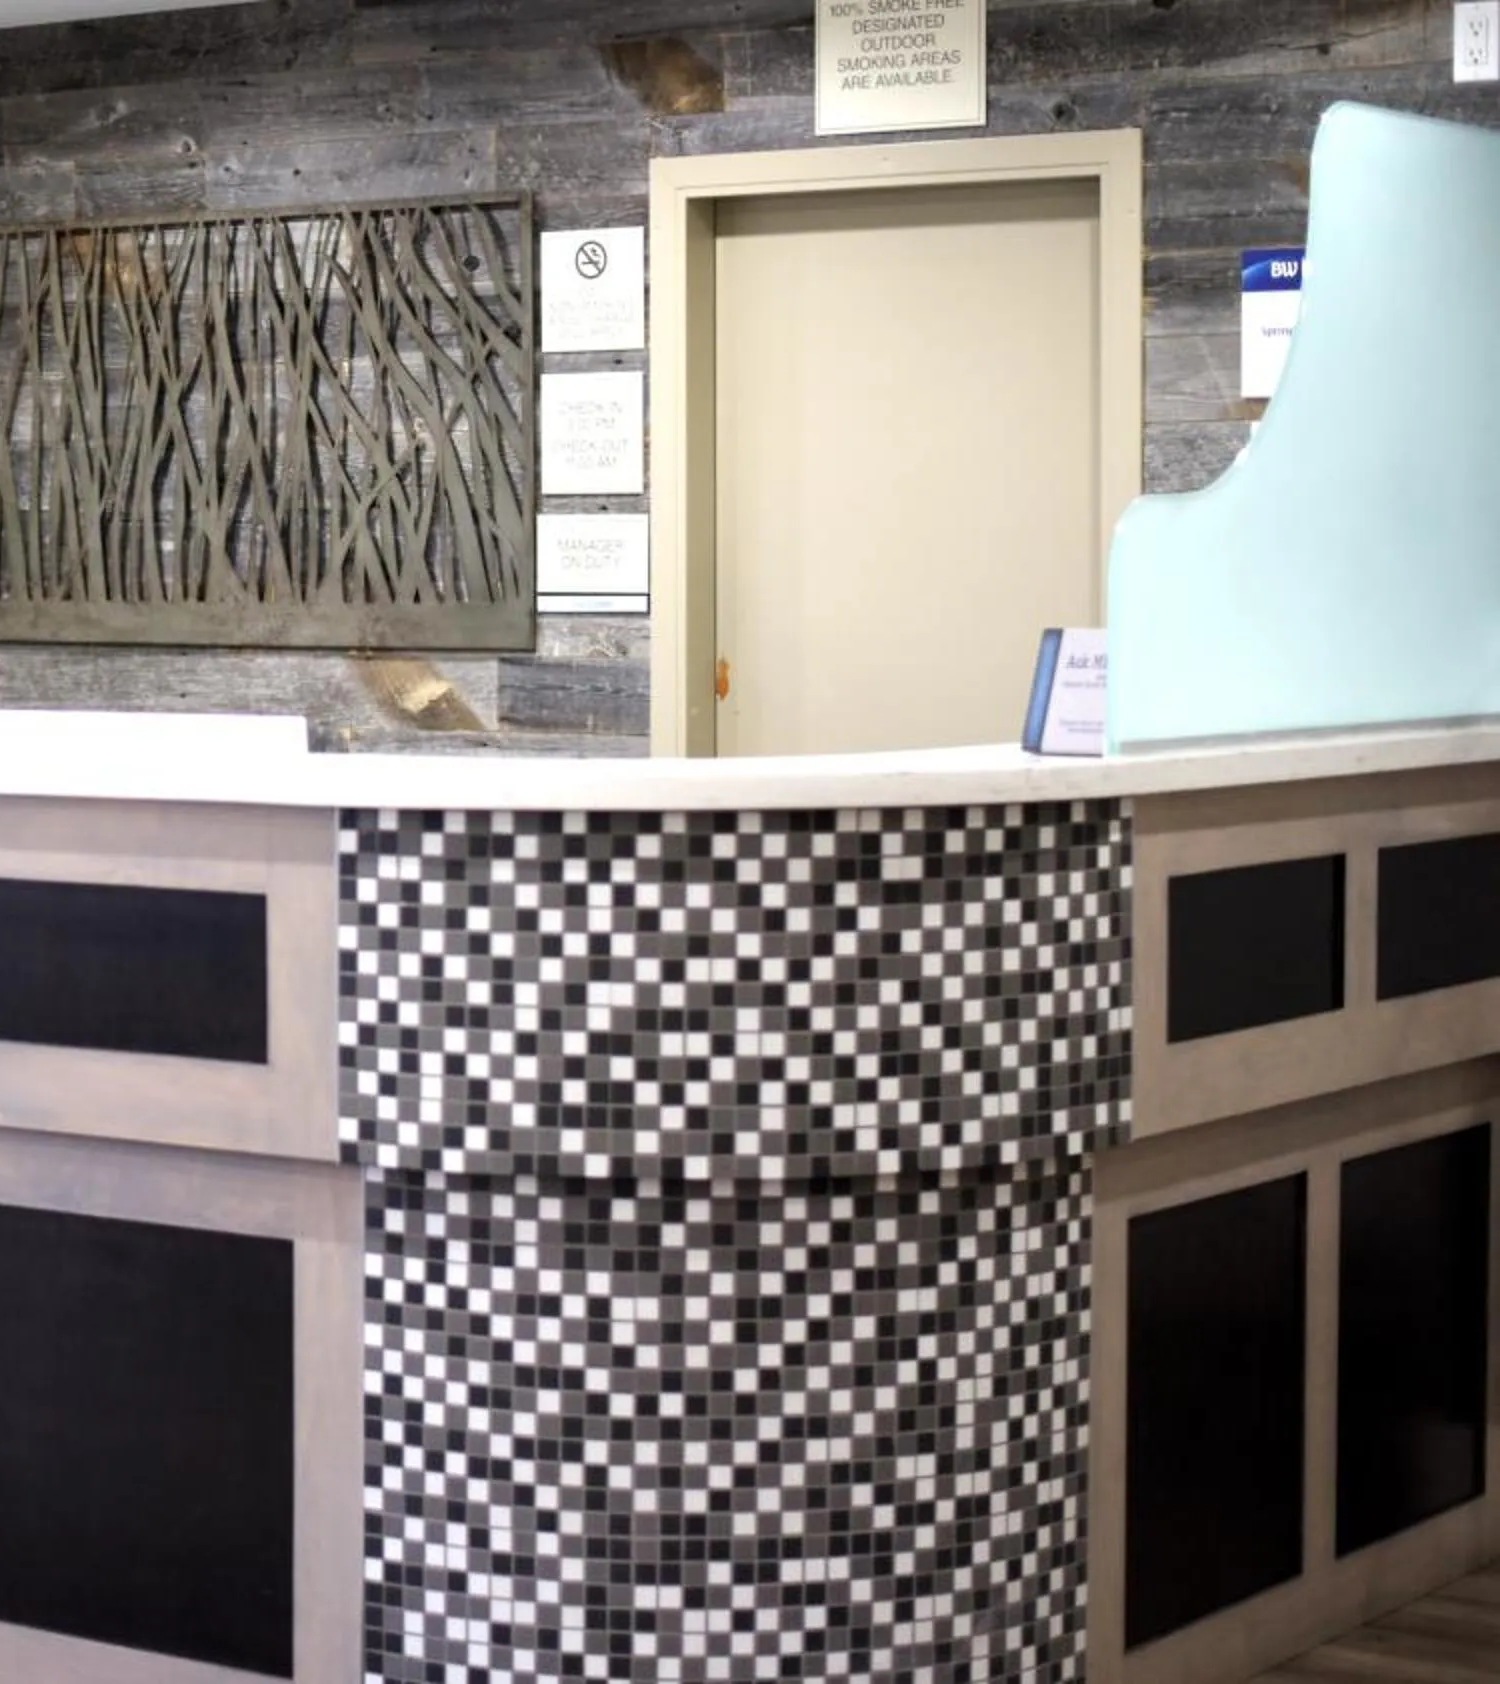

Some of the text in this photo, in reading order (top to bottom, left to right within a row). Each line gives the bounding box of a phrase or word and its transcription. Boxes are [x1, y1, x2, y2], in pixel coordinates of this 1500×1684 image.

[829, 4, 863, 17] 100%
[868, 0, 920, 15] SMOKE
[852, 14, 945, 34] DESIGNATED
[860, 33, 936, 51] OUTDOOR
[837, 50, 962, 73] SMOKING AREAS
[841, 75, 871, 91] ARE
[1271, 260, 1299, 278] BW
[556, 538, 626, 553] MANAGER
[584, 554, 621, 570] DUTY
